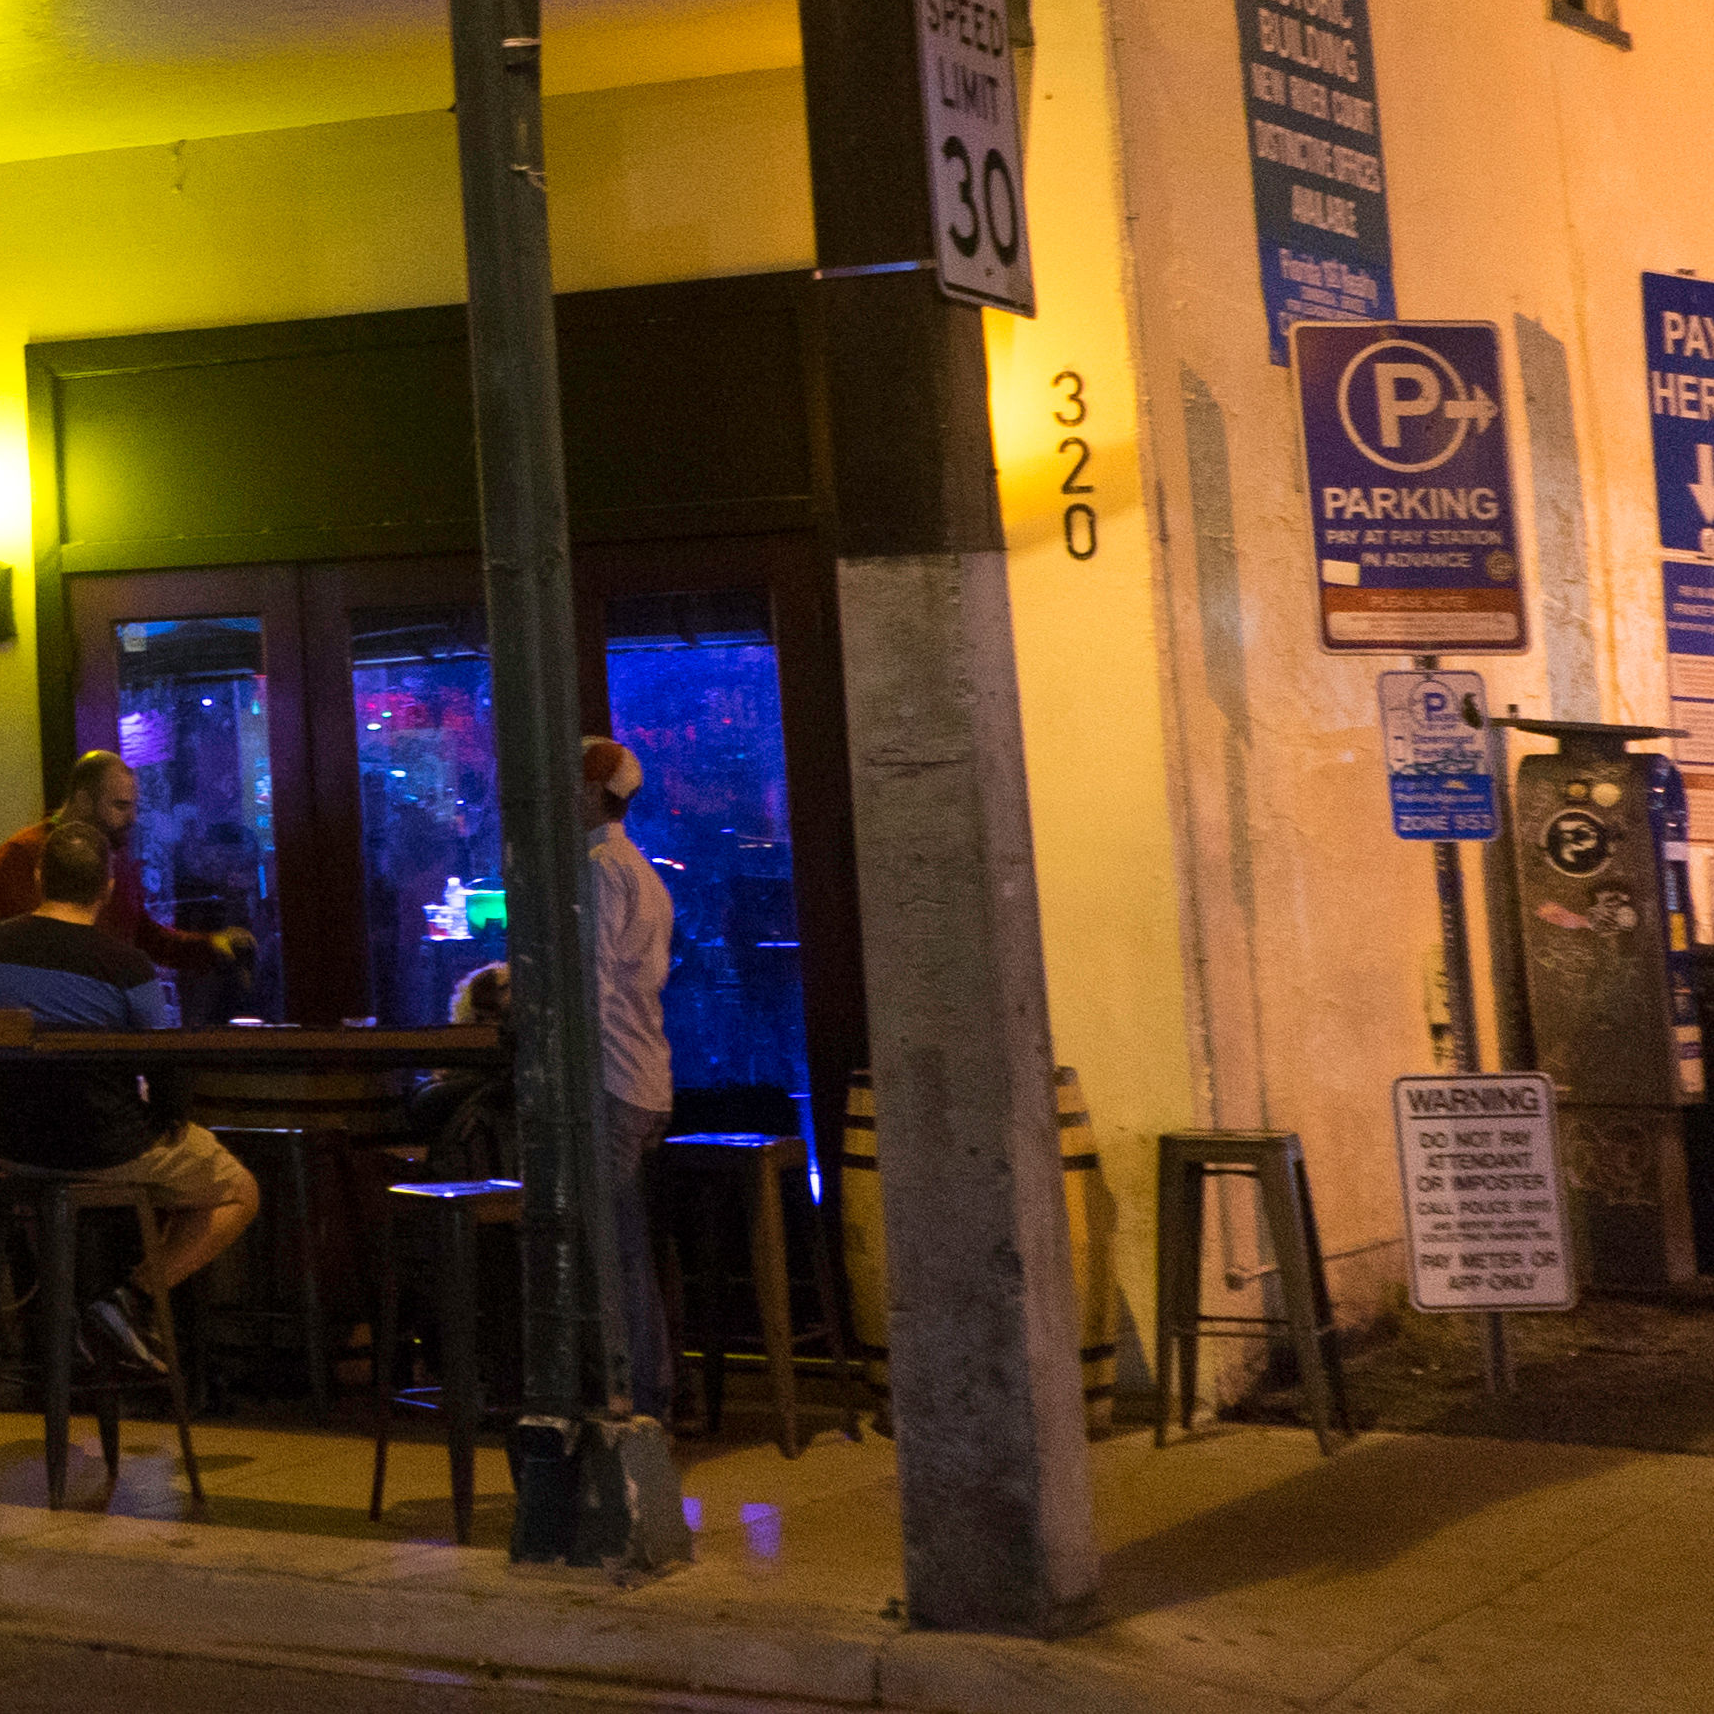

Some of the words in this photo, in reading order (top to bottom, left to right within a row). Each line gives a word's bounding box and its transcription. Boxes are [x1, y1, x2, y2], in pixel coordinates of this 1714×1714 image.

[1257, 7, 1359, 83] BUILDING
[938, 55, 1000, 125] LIMIT
[1250, 62, 1287, 106] NEW
[941, 135, 1019, 267] 30
[1323, 486, 1500, 520] PARKING
[1326, 529, 1359, 545] PAY
[1361, 529, 1387, 545] AT
[1388, 529, 1423, 545] PAY
[1427, 529, 1504, 545] STATION
[1384, 551, 1473, 568] ADVANCE
[1399, 815, 1449, 831] ZONE
[1407, 1086, 1541, 1113] WARNING
[1420, 1132, 1449, 1148] DO
[1455, 1131, 1494, 1147] NOT
[1499, 1130, 1532, 1147] PAY
[1426, 1152, 1533, 1171] ATTENDANT
[1417, 1175, 1445, 1192] OR
[1452, 1173, 1546, 1191] IMPOSTER
[1420, 1253, 1452, 1270] PAY
[1458, 1251, 1523, 1269] METER
[1530, 1249, 1559, 1268] OR
